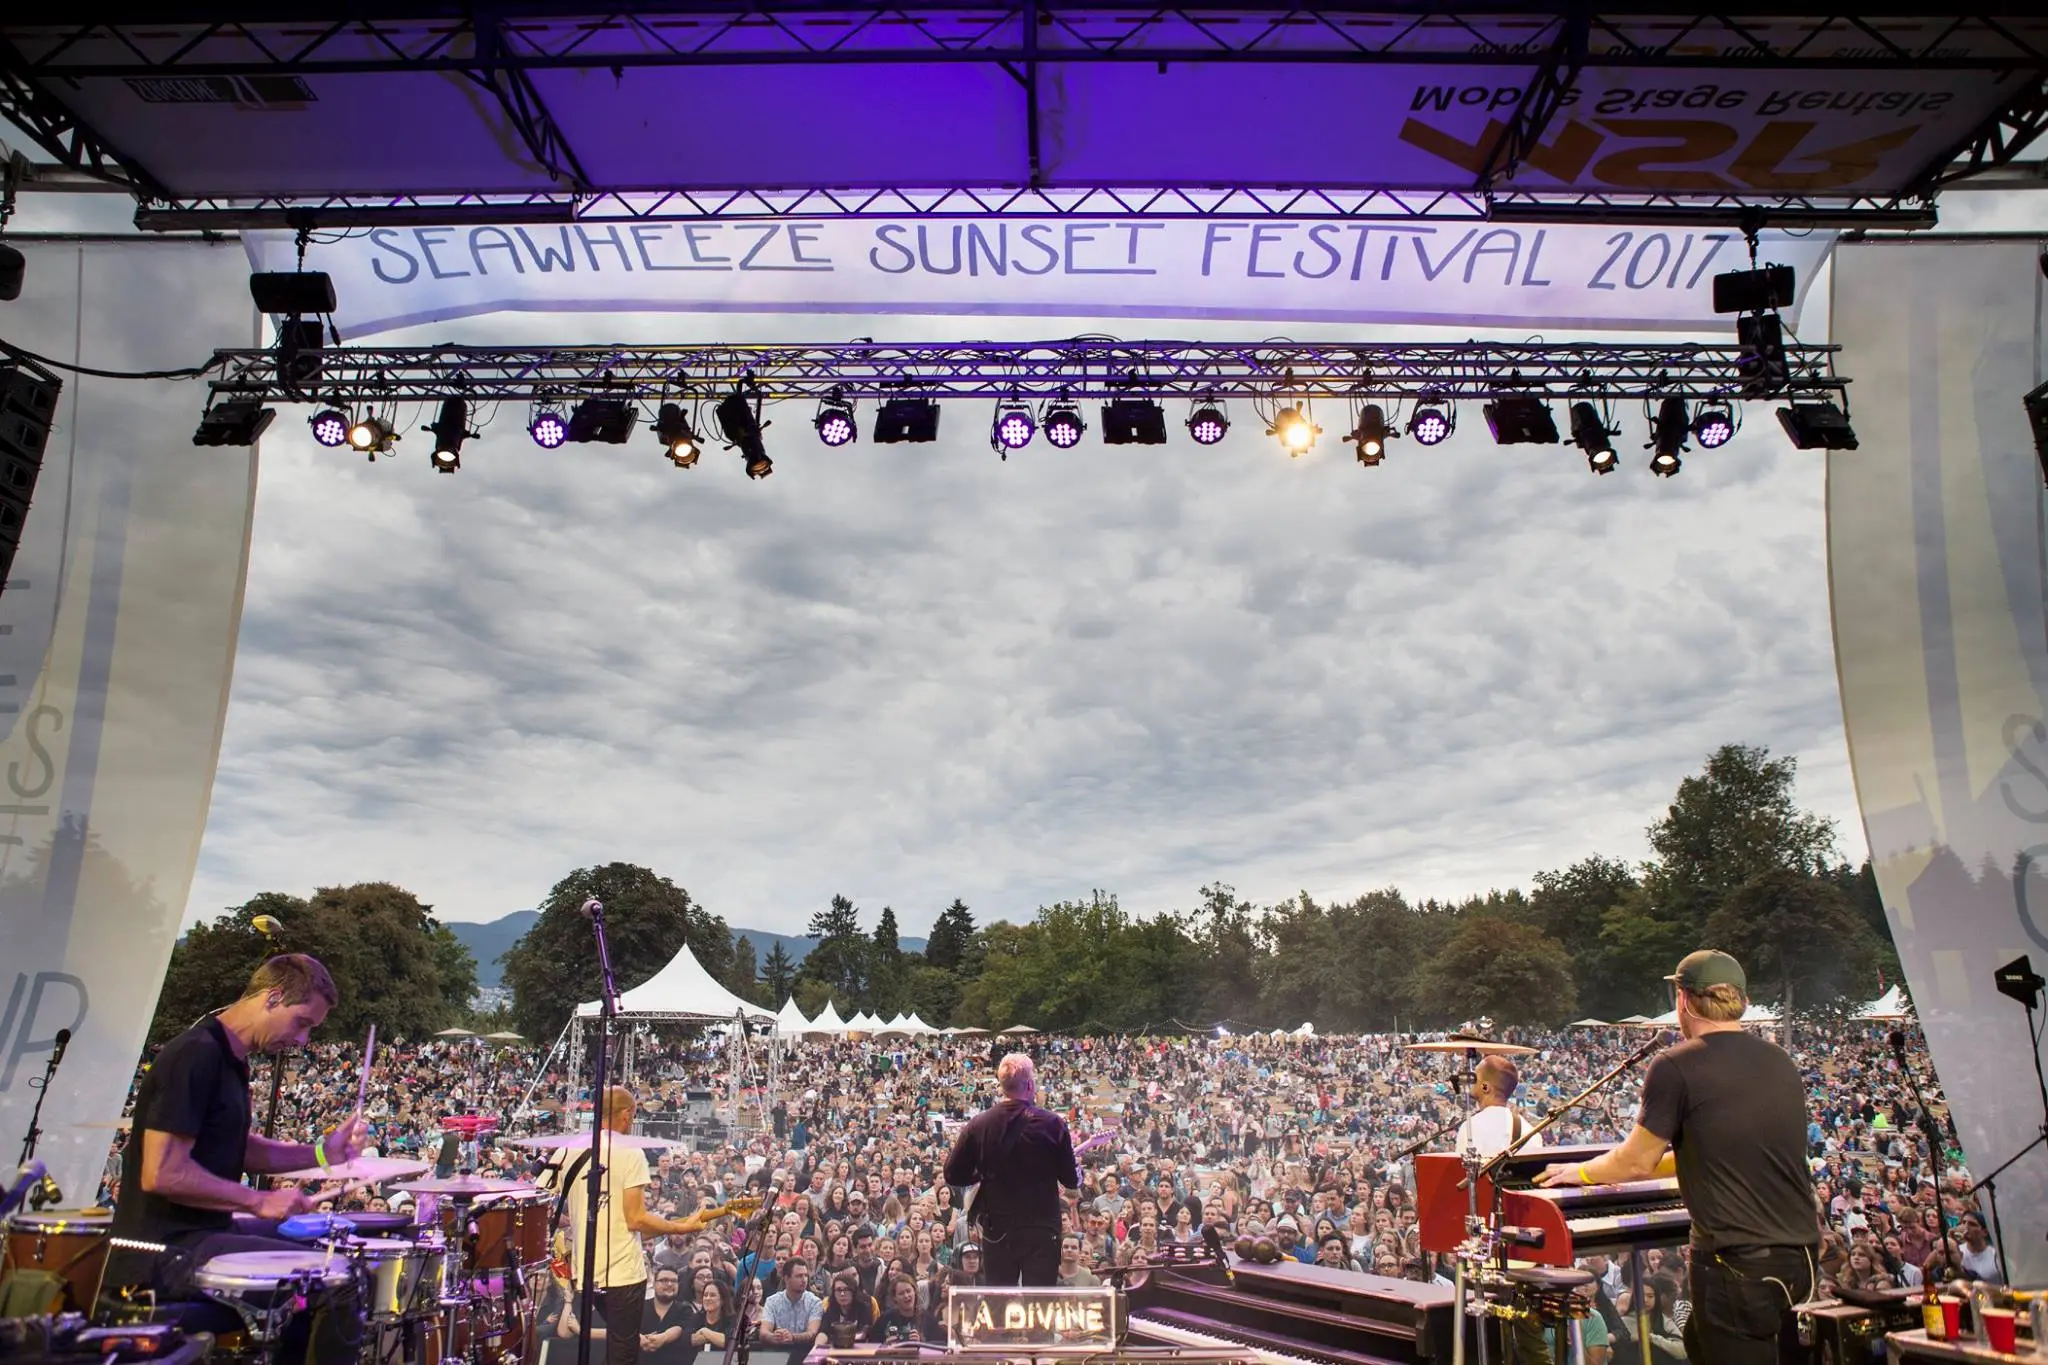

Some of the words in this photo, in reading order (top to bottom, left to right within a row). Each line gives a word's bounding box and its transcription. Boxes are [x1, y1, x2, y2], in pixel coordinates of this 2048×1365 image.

[371, 223, 834, 284] SEAWHEEZE
[870, 222, 1165, 277] SUNSET
[1200, 223, 1553, 288] FESTIVAL
[1587, 231, 1730, 290] 2017
[959, 1299, 996, 1335] LA
[1004, 1300, 1106, 1332] DIVINE
